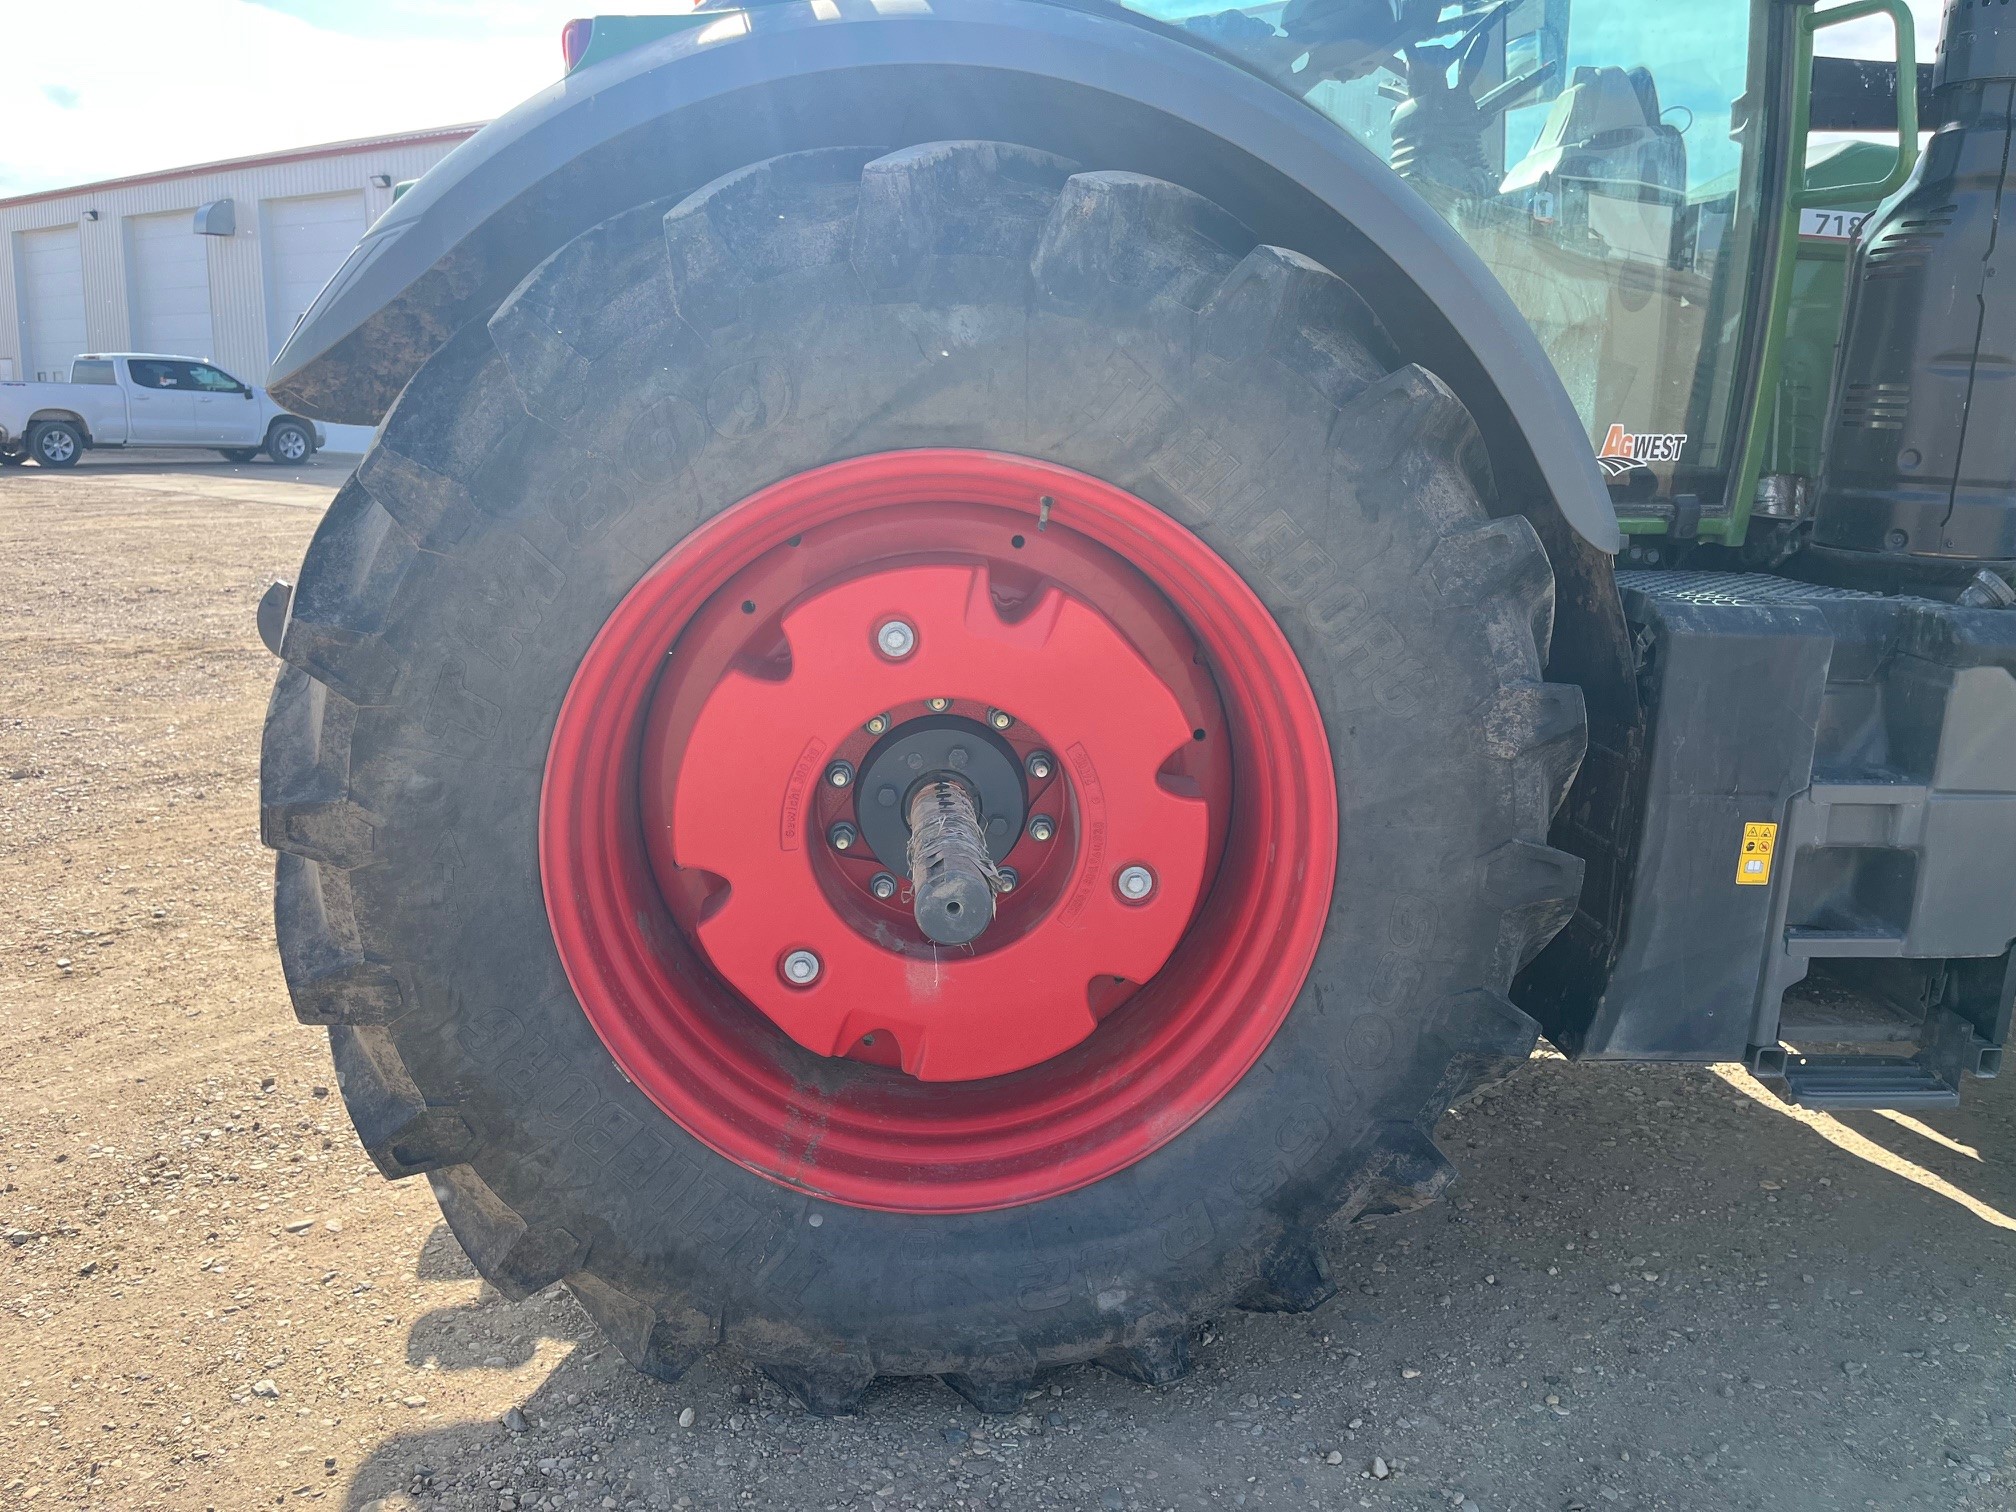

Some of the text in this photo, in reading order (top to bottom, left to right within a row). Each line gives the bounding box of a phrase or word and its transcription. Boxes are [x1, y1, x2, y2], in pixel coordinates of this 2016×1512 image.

[1815, 213, 1864, 236] 718
[1082, 348, 1438, 716] TRELLEBORG
[456, 1006, 827, 1312] TRELLEBORG
